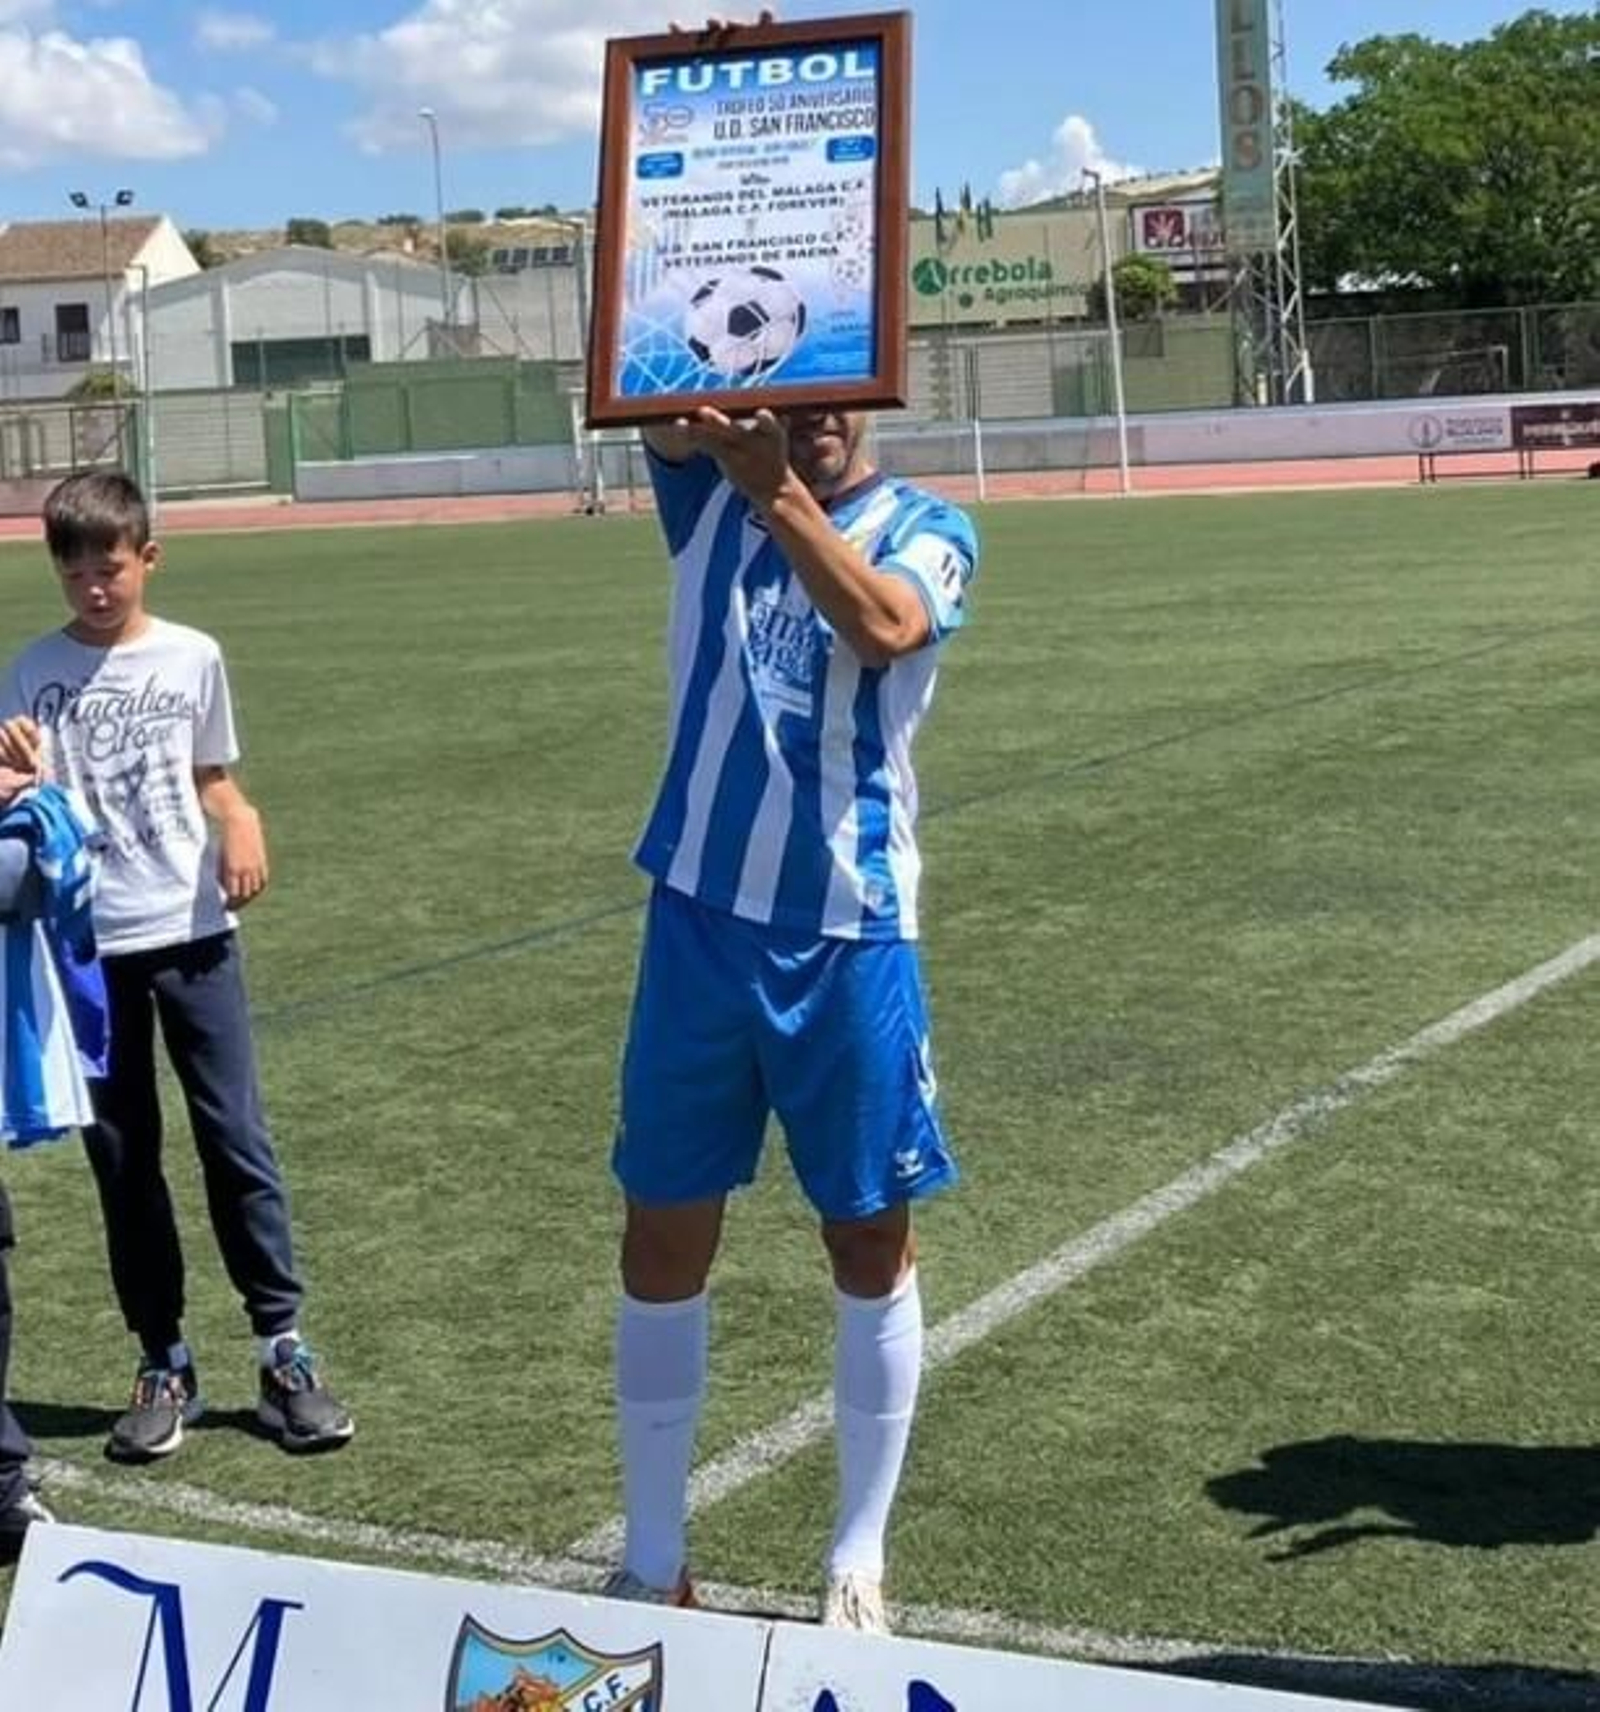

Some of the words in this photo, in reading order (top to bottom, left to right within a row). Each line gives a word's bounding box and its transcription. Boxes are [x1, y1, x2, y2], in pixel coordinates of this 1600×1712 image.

[641, 52, 875, 96] FÚTBOL
[714, 97, 765, 116] TROFEO
[714, 118, 745, 141] U.D.
[750, 114, 782, 138] SAN
[785, 107, 876, 134] FRANCISCO
[642, 189, 734, 209] VETERANOS
[738, 187, 768, 200] DEL
[692, 240, 724, 253] SAN
[727, 234, 818, 251] FRANCISCO
[663, 252, 758, 269] VETERANOS
[761, 250, 781, 263] DE
[912, 257, 1053, 296] Arrebola
